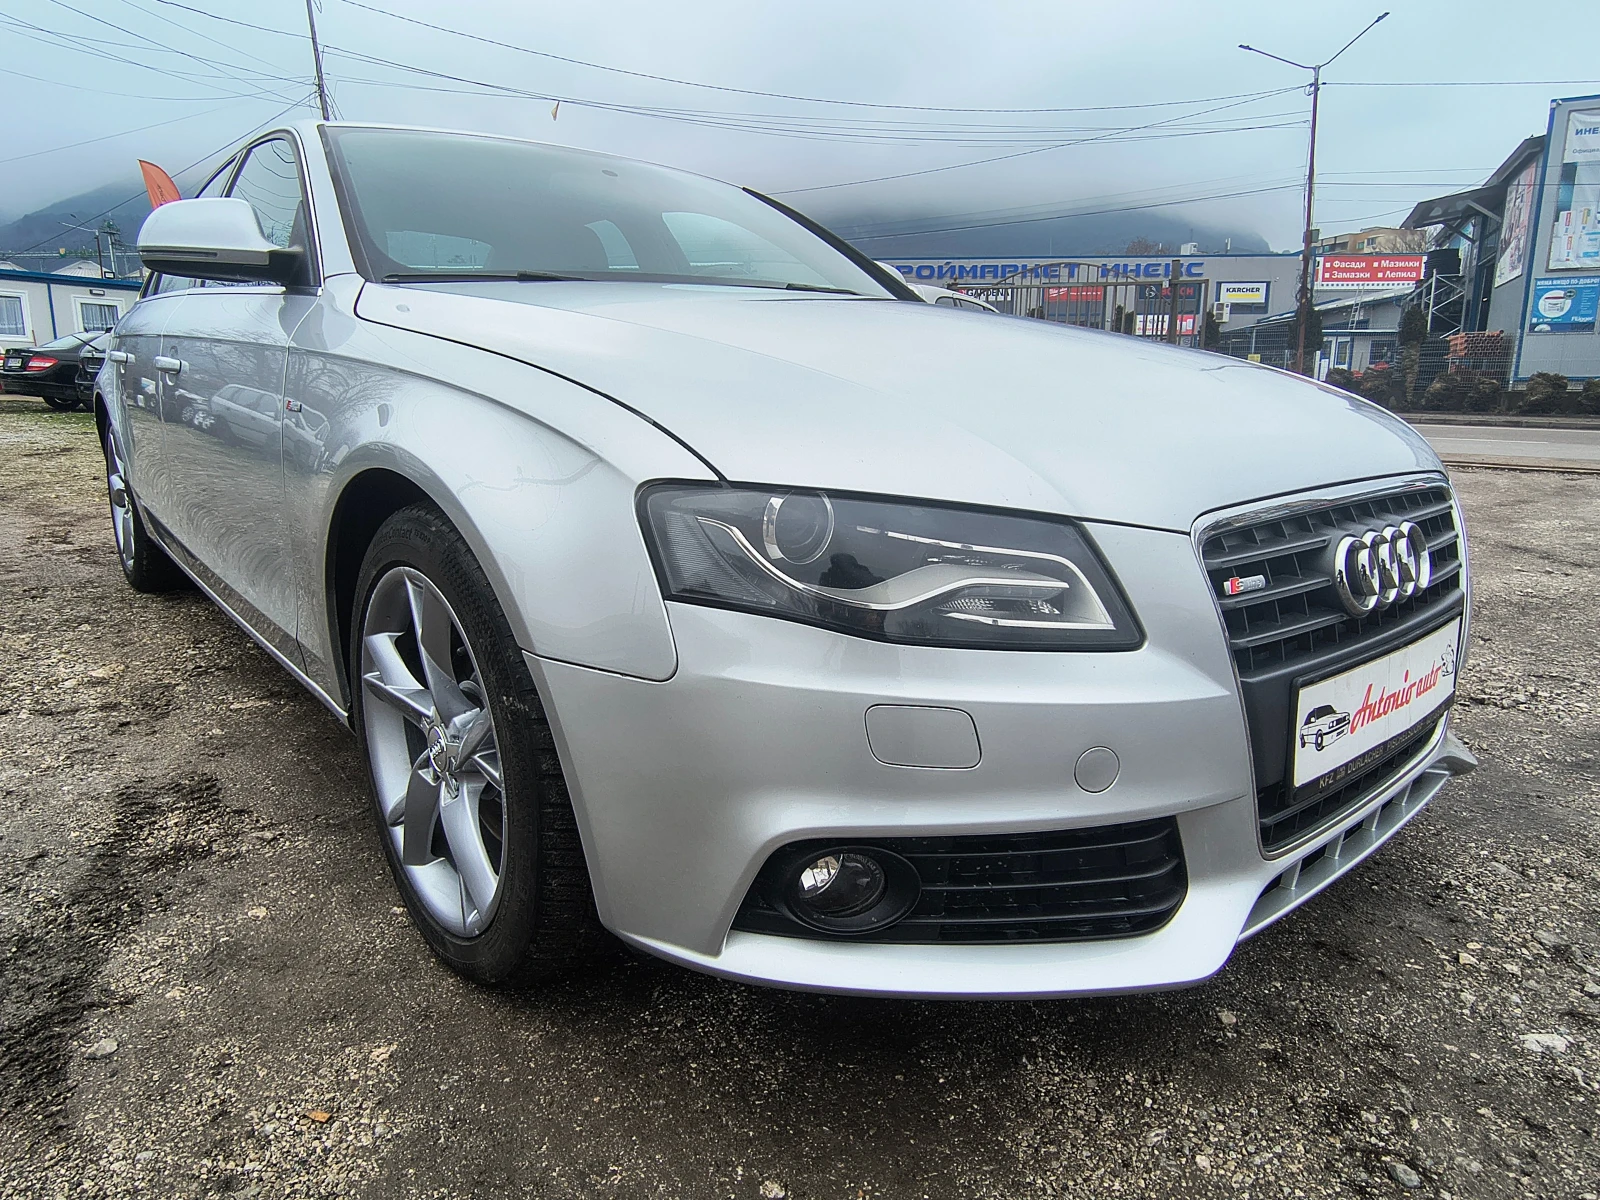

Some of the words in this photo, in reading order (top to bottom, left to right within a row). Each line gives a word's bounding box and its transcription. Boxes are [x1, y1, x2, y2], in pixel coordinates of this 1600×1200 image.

[1575, 127, 1600, 136] ИНЕ
[894, 261, 1078, 279] РОЙМАРКЕТ
[1333, 260, 1366, 268] Фасади
[1380, 260, 1420, 268] Мазилки
[1331, 271, 1371, 279] Замазки
[1349, 669, 1416, 735] Antonio
[1415, 660, 1442, 699] auto
[1319, 773, 1334, 789] KFZ
[1347, 746, 1383, 774] DURLACHER
